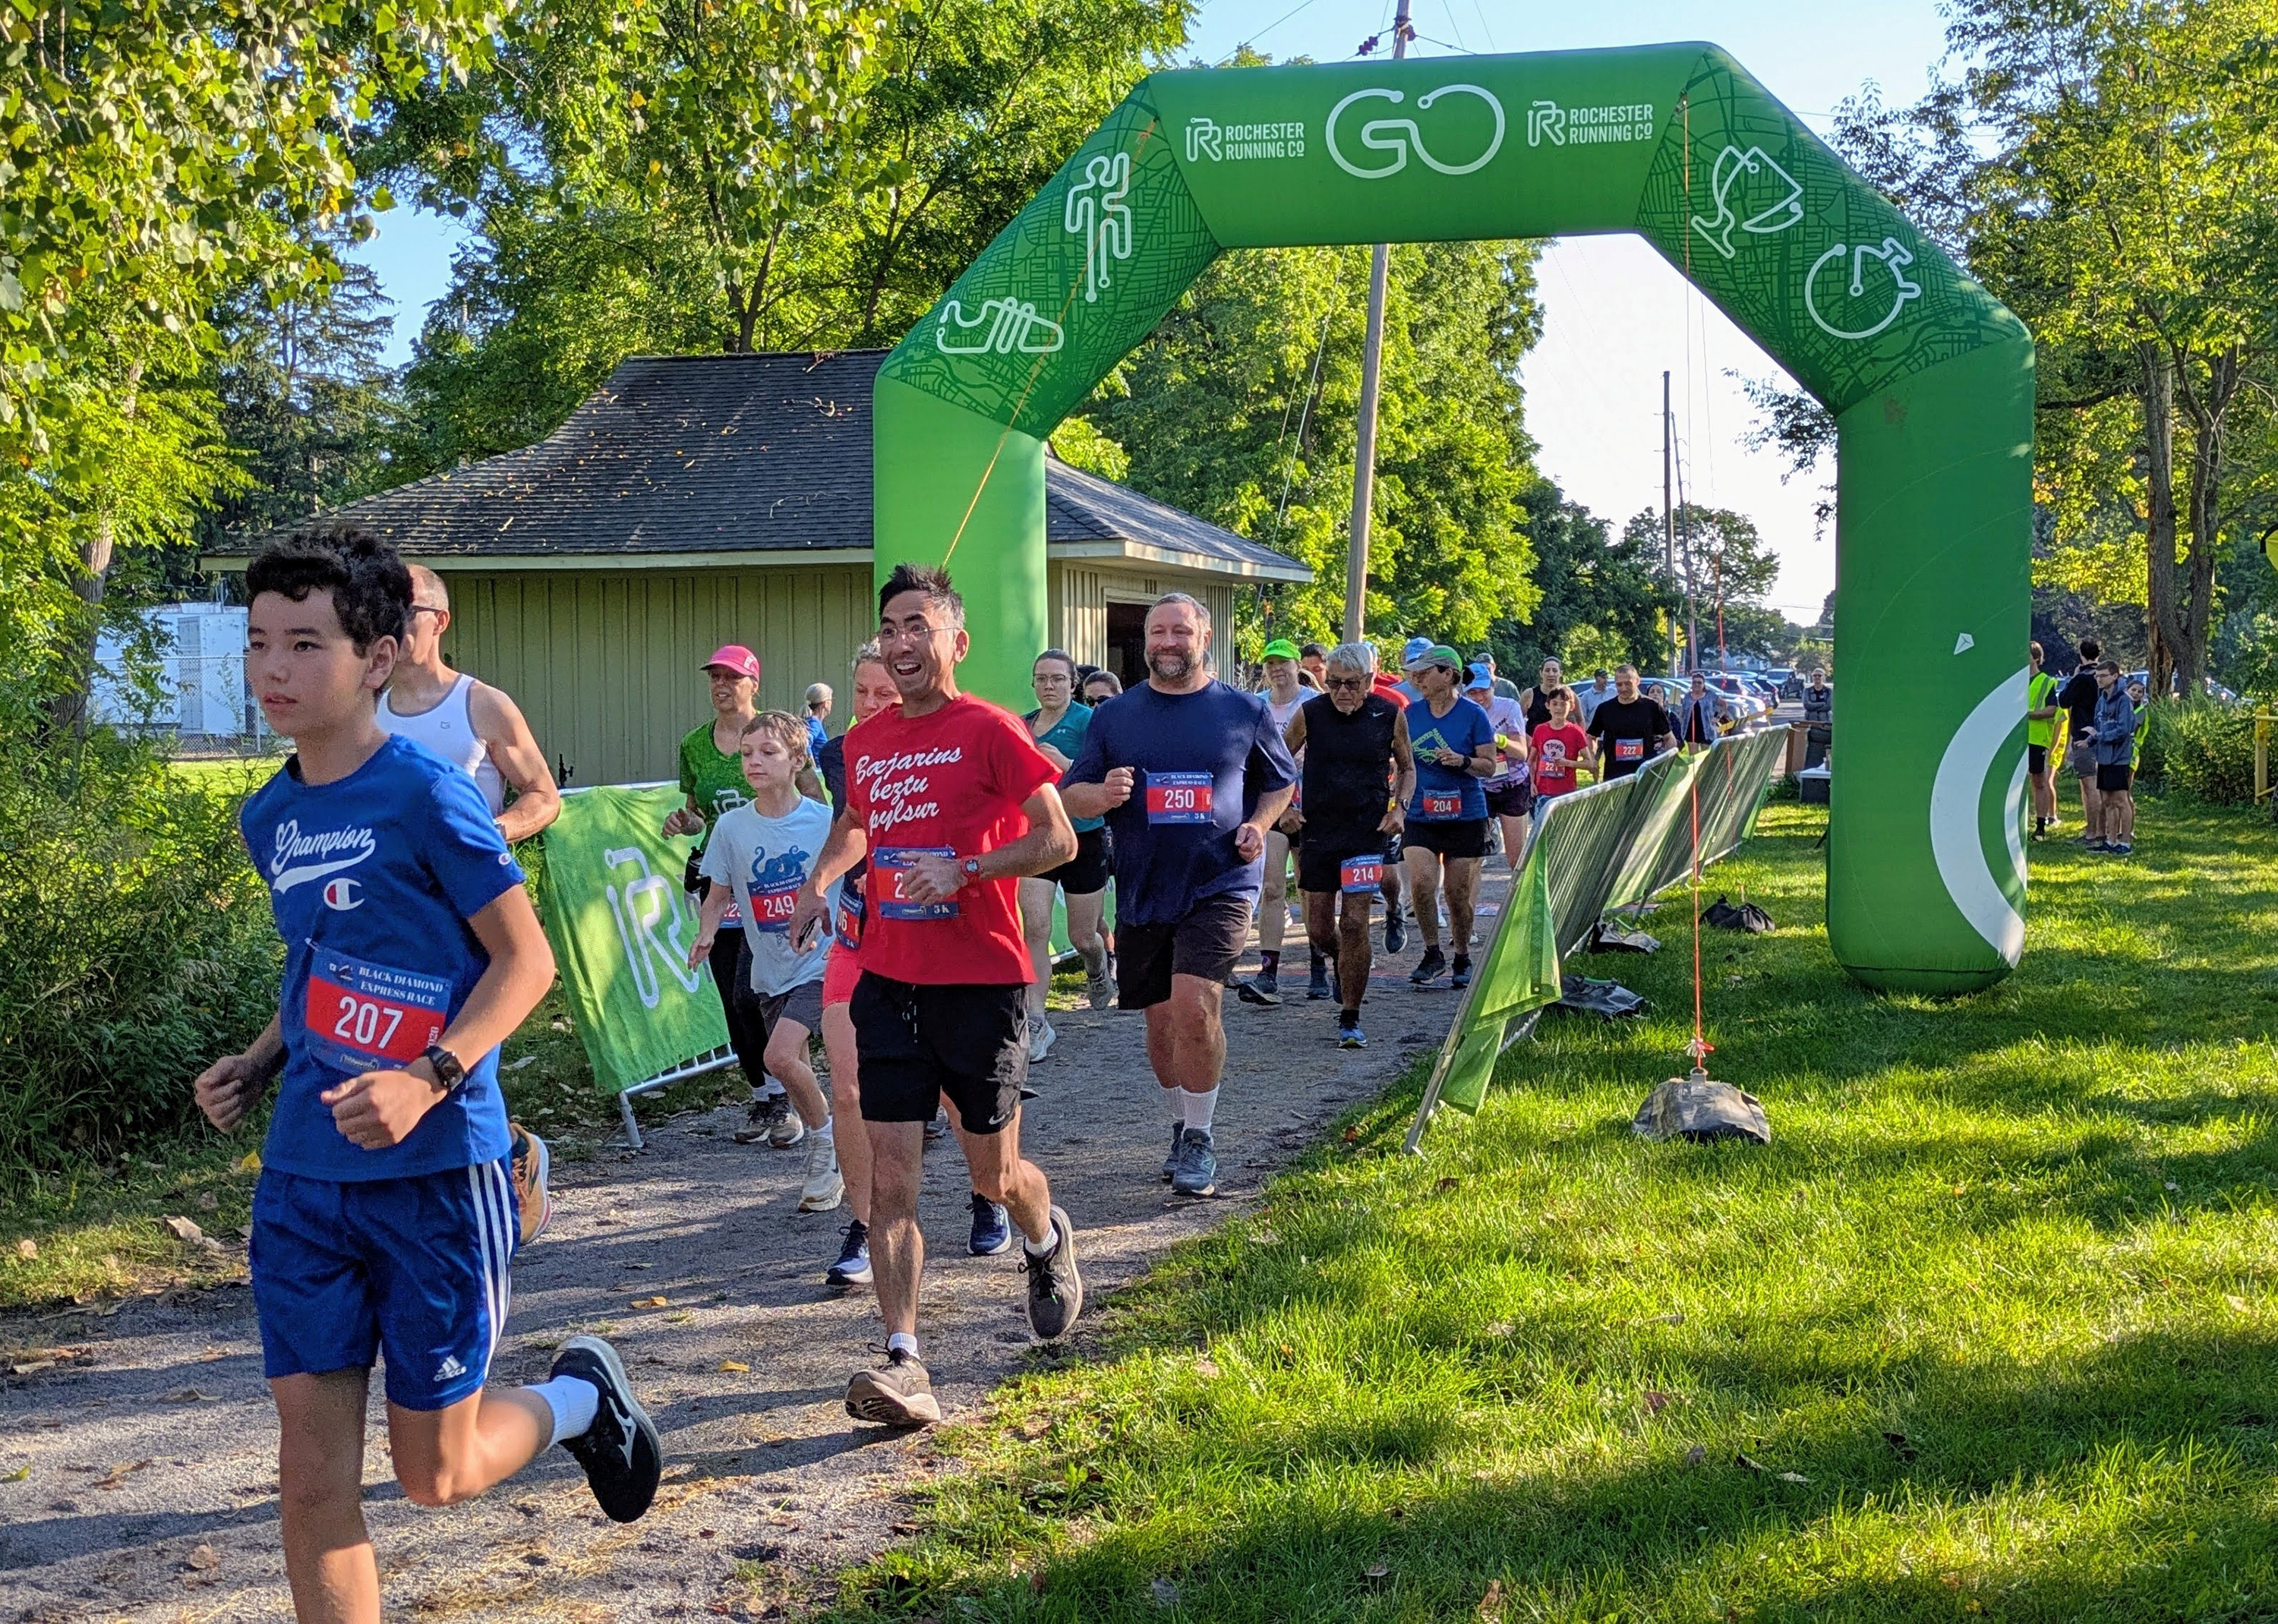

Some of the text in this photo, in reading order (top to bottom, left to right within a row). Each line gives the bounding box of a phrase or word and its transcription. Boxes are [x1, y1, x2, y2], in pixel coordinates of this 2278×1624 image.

[1570, 104, 1653, 125] ROCHESTER
[1226, 122, 1304, 141] ROCHESTER
[1570, 125, 1632, 144] RUNNING
[1226, 142, 1285, 160] RUNNING
[856, 747, 963, 785] Bæjarins
[869, 774, 929, 805] beztu
[1164, 789, 1194, 809] 250
[1433, 799, 1452, 812] 204
[869, 799, 940, 837] pylsur
[270, 818, 377, 876] Champion
[1353, 867, 1374, 883] 214
[763, 895, 796, 918] 249
[838, 906, 847, 932] 06
[358, 967, 444, 993] BLACK DIAMOND
[360, 980, 437, 1006] EXPRESS RACE
[334, 995, 403, 1049] 207
